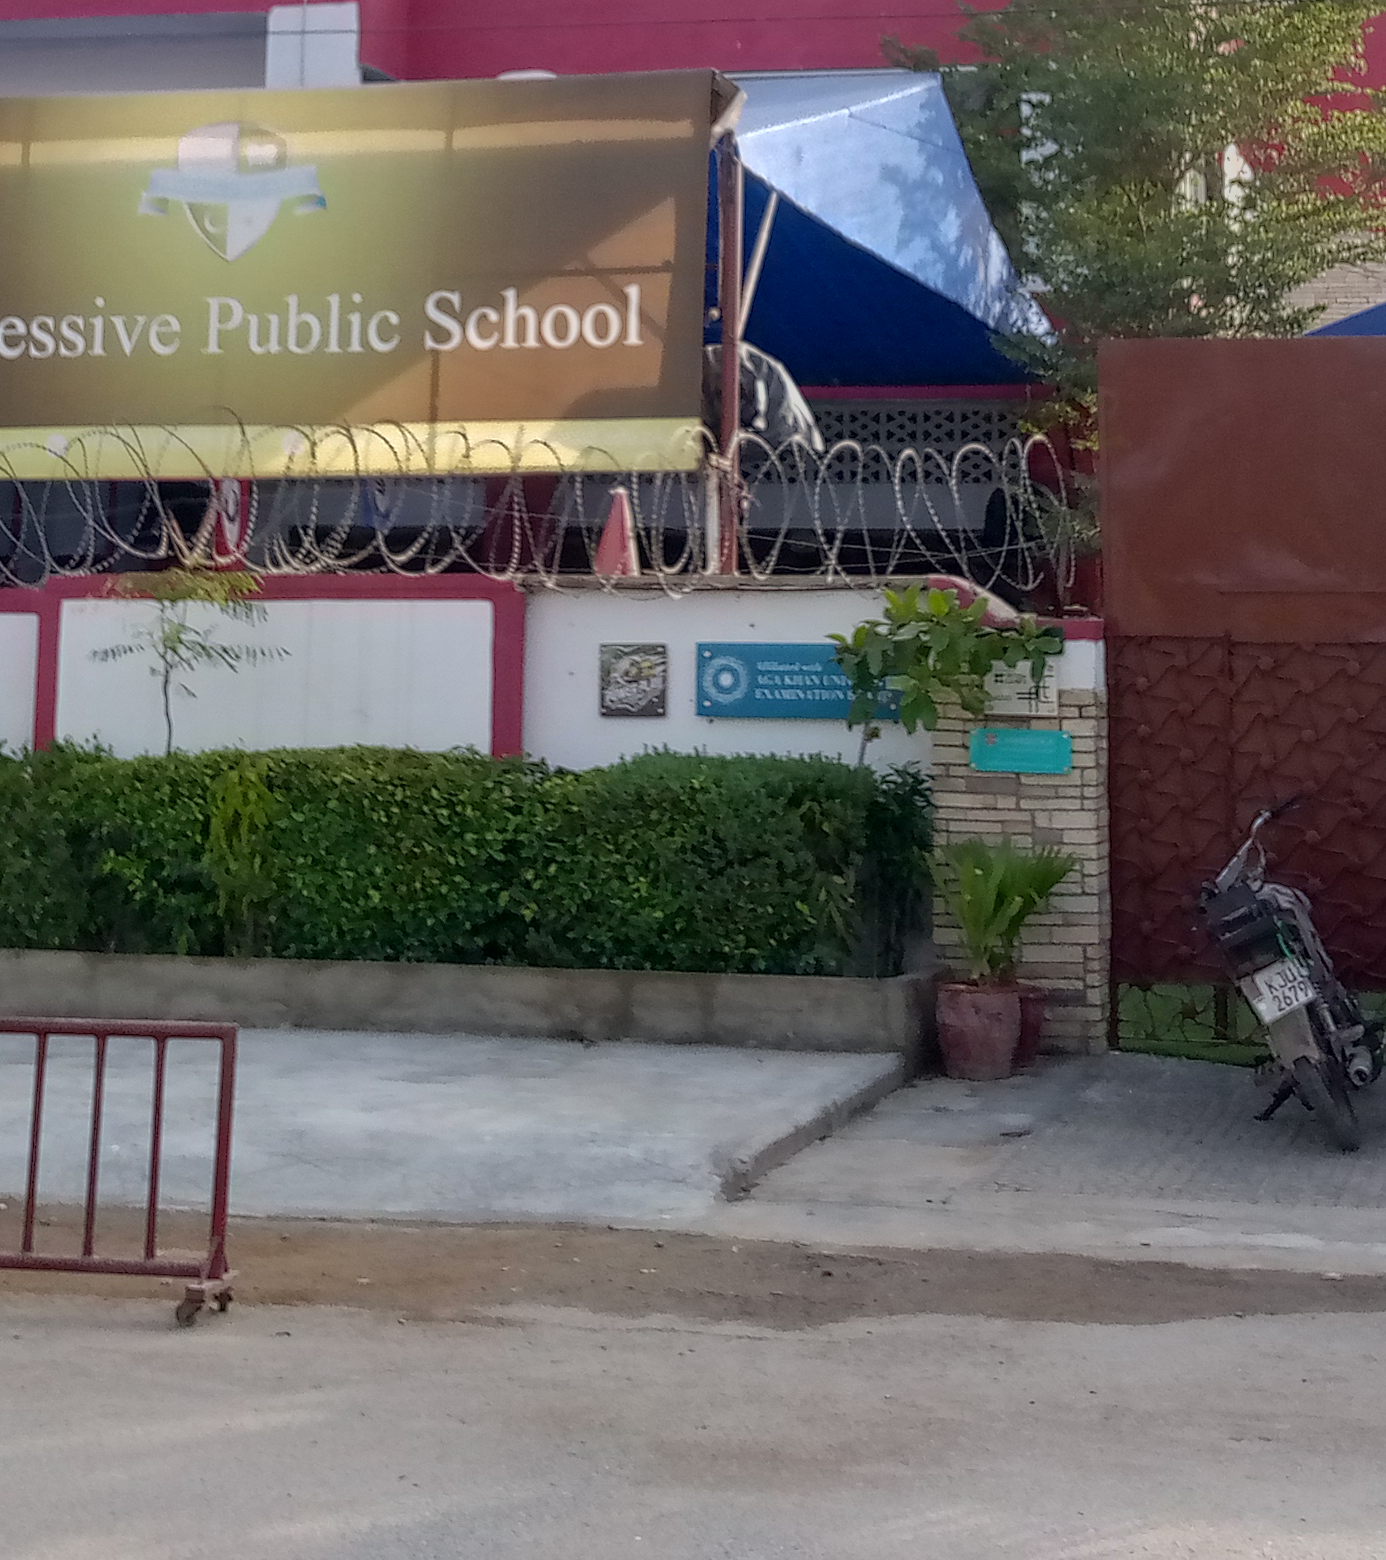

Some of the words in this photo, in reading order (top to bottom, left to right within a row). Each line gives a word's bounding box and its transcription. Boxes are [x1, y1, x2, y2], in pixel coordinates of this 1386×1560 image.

[200, 292, 401, 355] Public
[422, 283, 645, 351] School
[1272, 981, 1309, 1012] 2679
